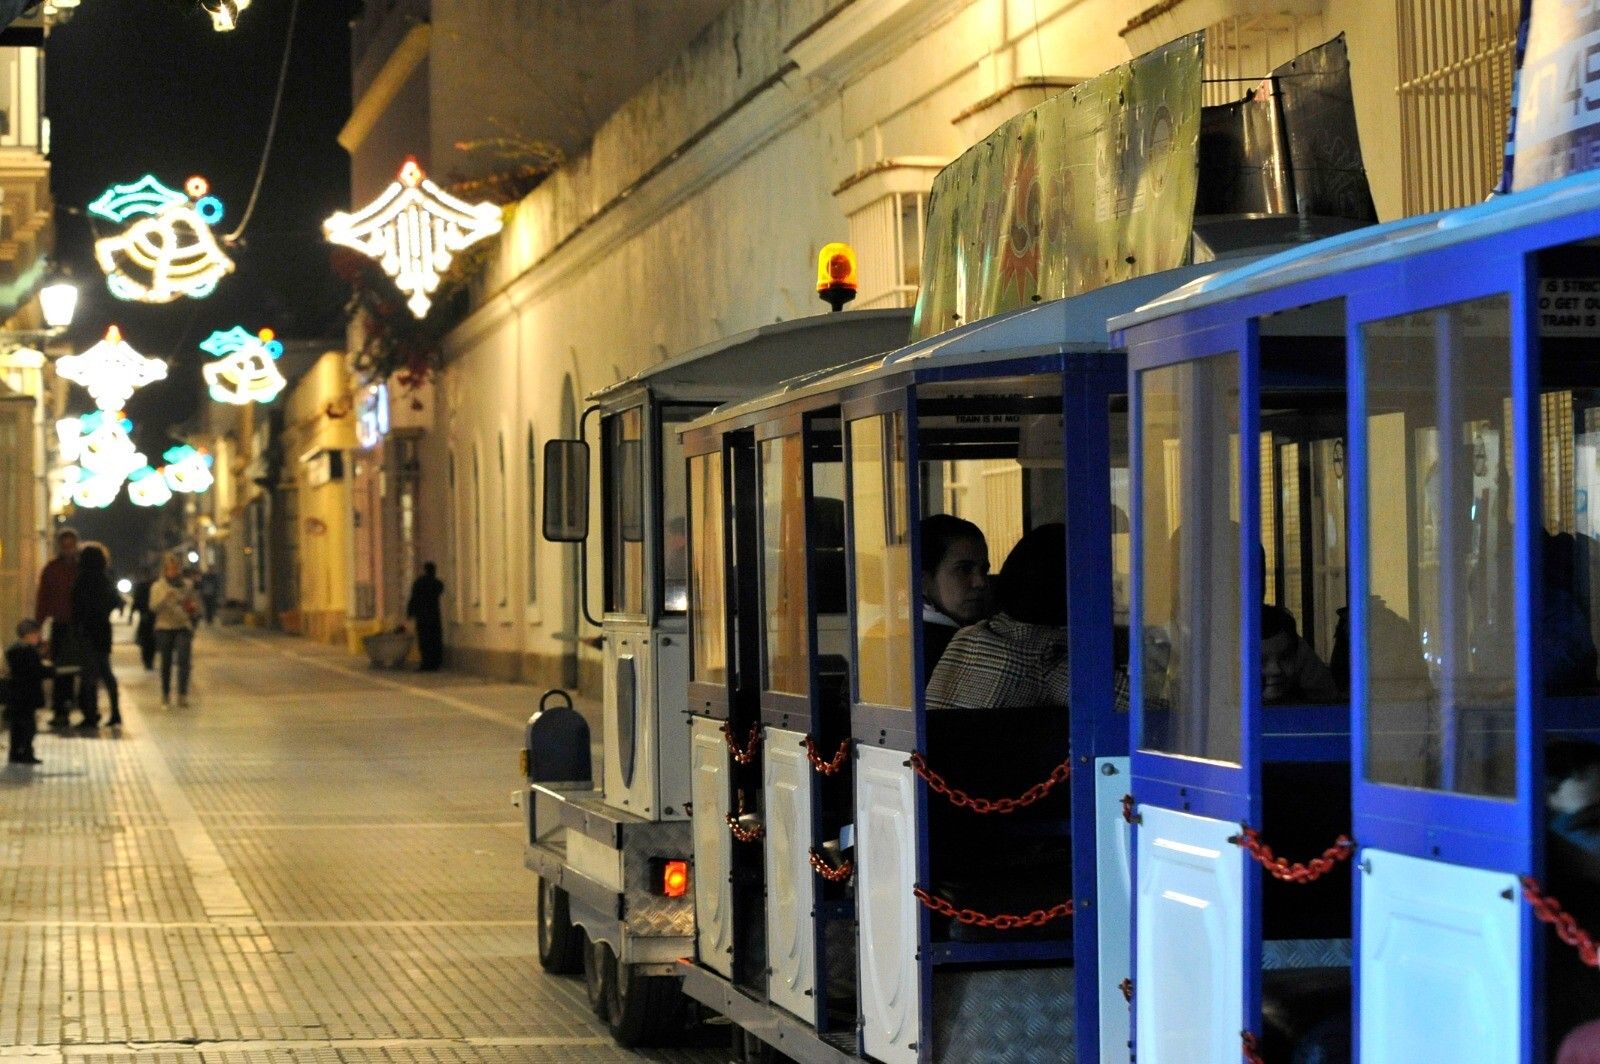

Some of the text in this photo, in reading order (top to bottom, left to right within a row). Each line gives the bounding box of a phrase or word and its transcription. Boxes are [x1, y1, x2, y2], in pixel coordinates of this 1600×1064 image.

[1554, 297, 1580, 310] GET
[1542, 314, 1597, 327] TRAIN IS
[956, 415, 981, 424] TRAIN
[982, 415, 991, 424] IS
[993, 415, 1003, 423] IN
